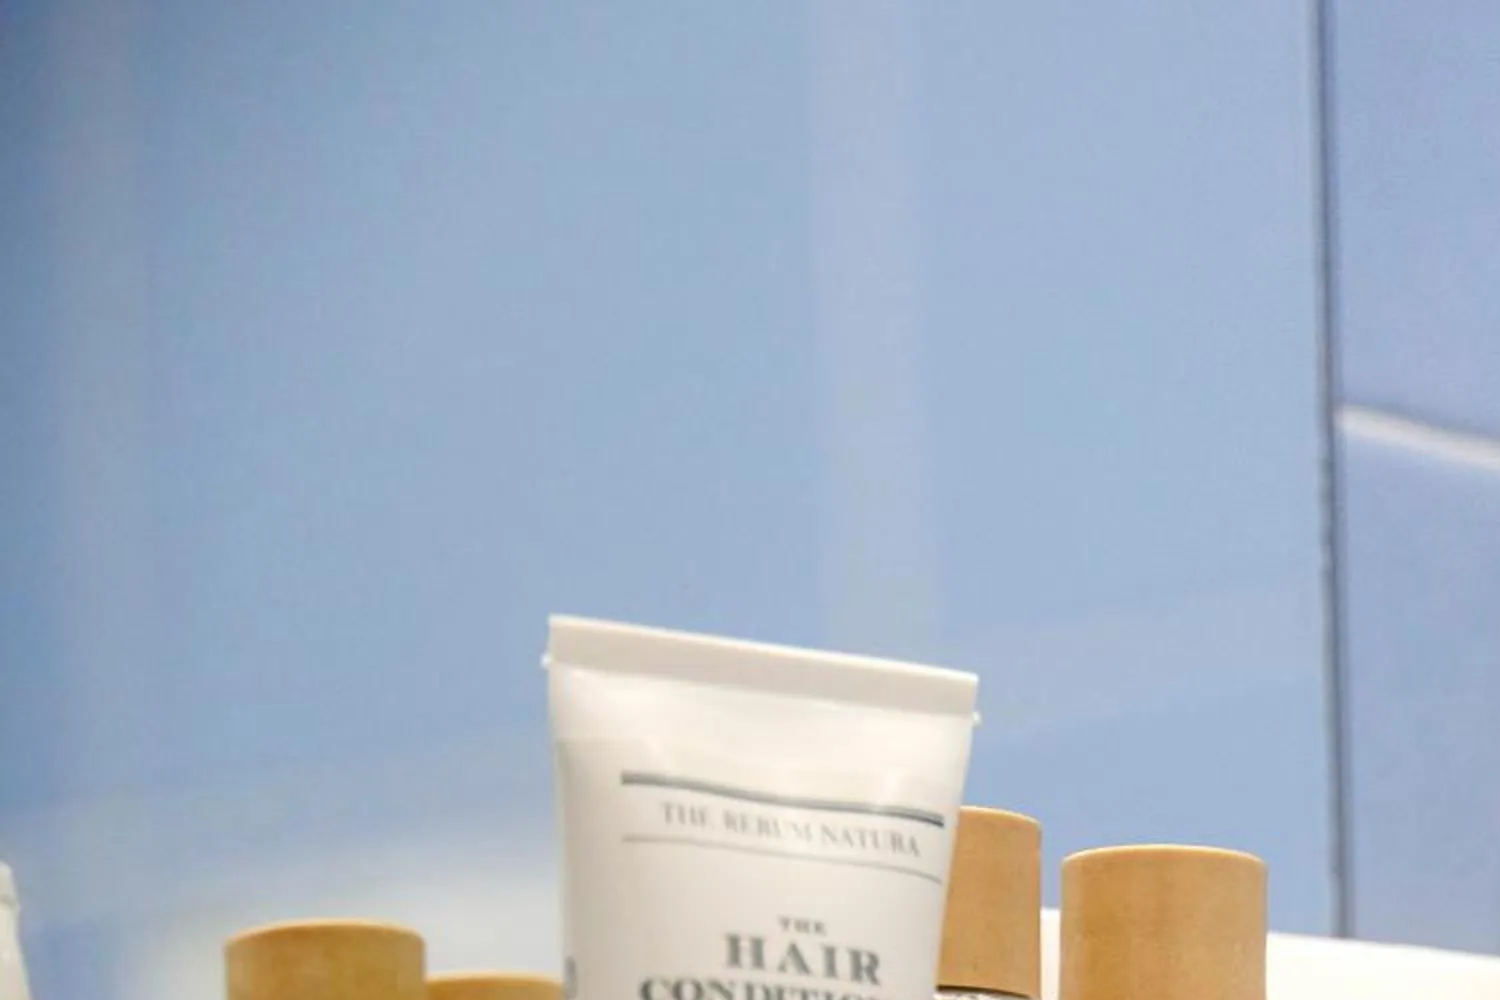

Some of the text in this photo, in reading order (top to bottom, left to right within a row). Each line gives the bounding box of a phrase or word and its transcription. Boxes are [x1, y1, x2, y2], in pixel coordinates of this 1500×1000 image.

[662, 802, 920, 857] THE RERUM NATURA
[779, 916, 826, 934] THE
[725, 932, 880, 986] HAIR
